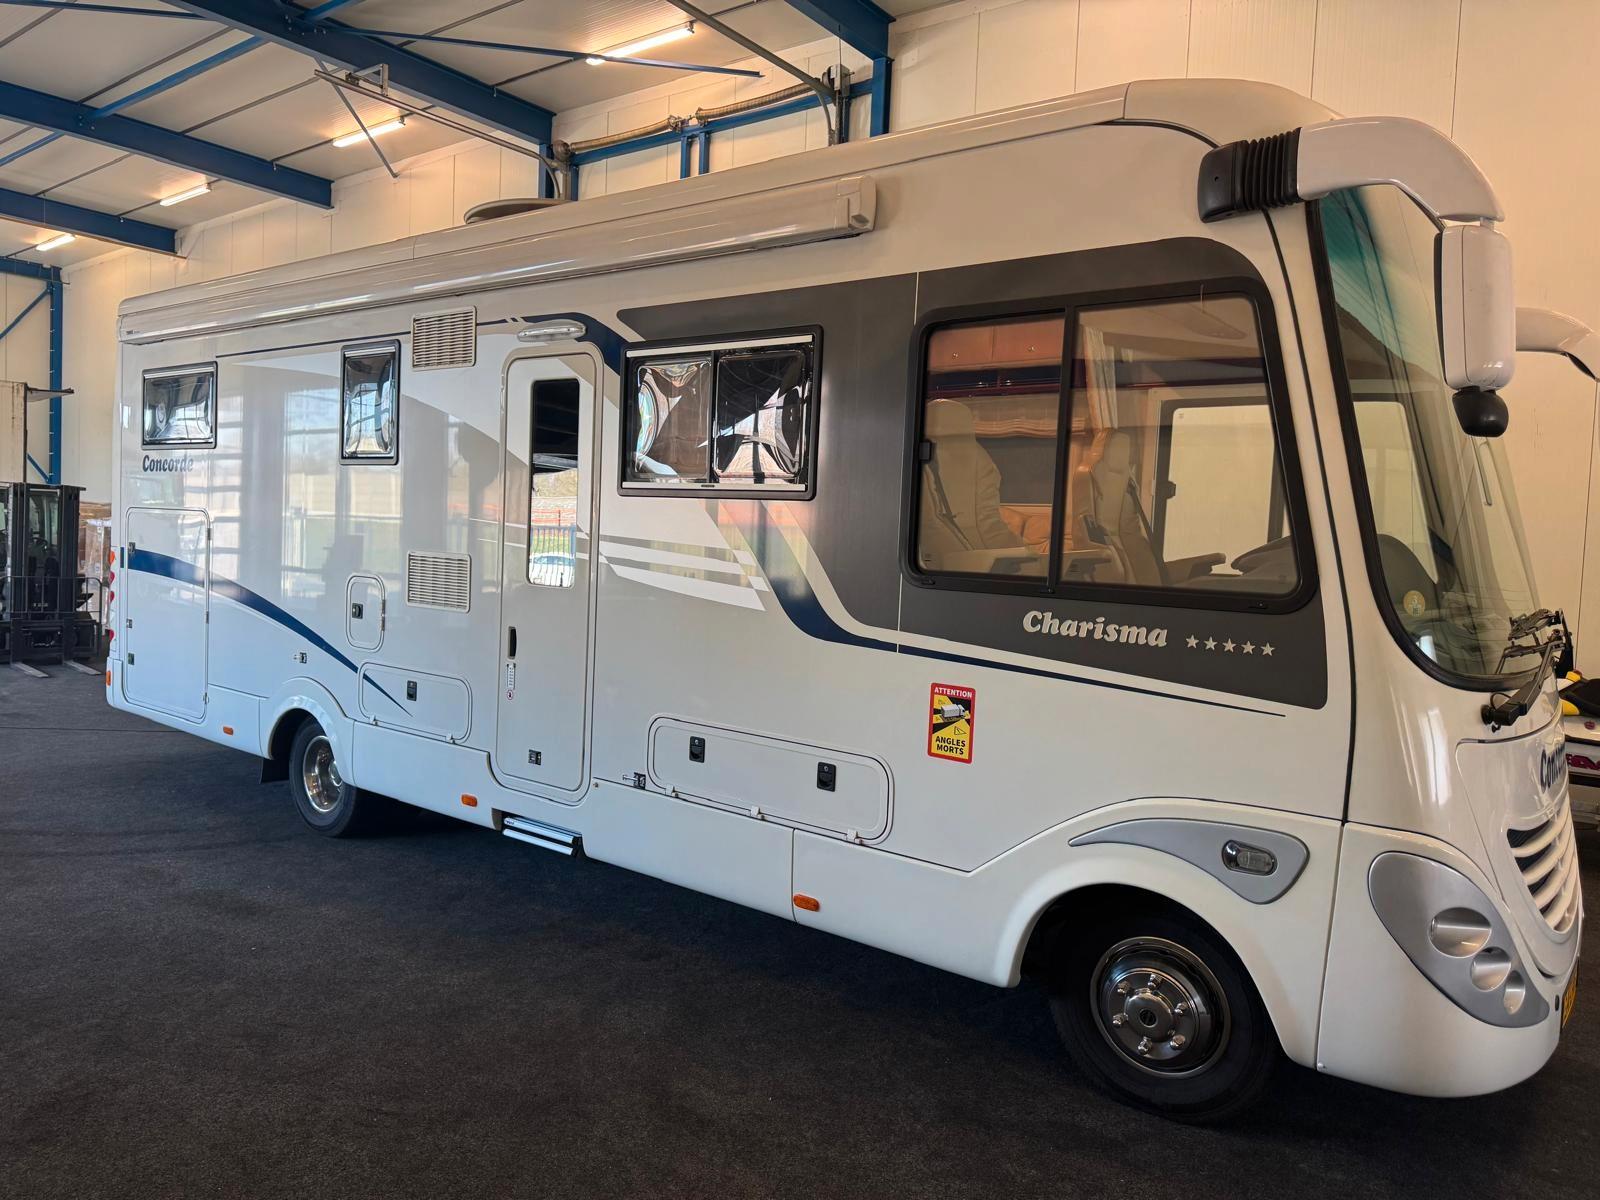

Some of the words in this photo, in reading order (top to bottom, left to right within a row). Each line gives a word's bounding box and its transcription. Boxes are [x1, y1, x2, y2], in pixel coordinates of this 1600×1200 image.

[142, 454, 194, 473] Concorde
[1022, 610, 1169, 648] Charisma
[934, 686, 973, 699] ATTENTION
[935, 735, 967, 748] ANGLES
[936, 743, 965, 756] MORTS
